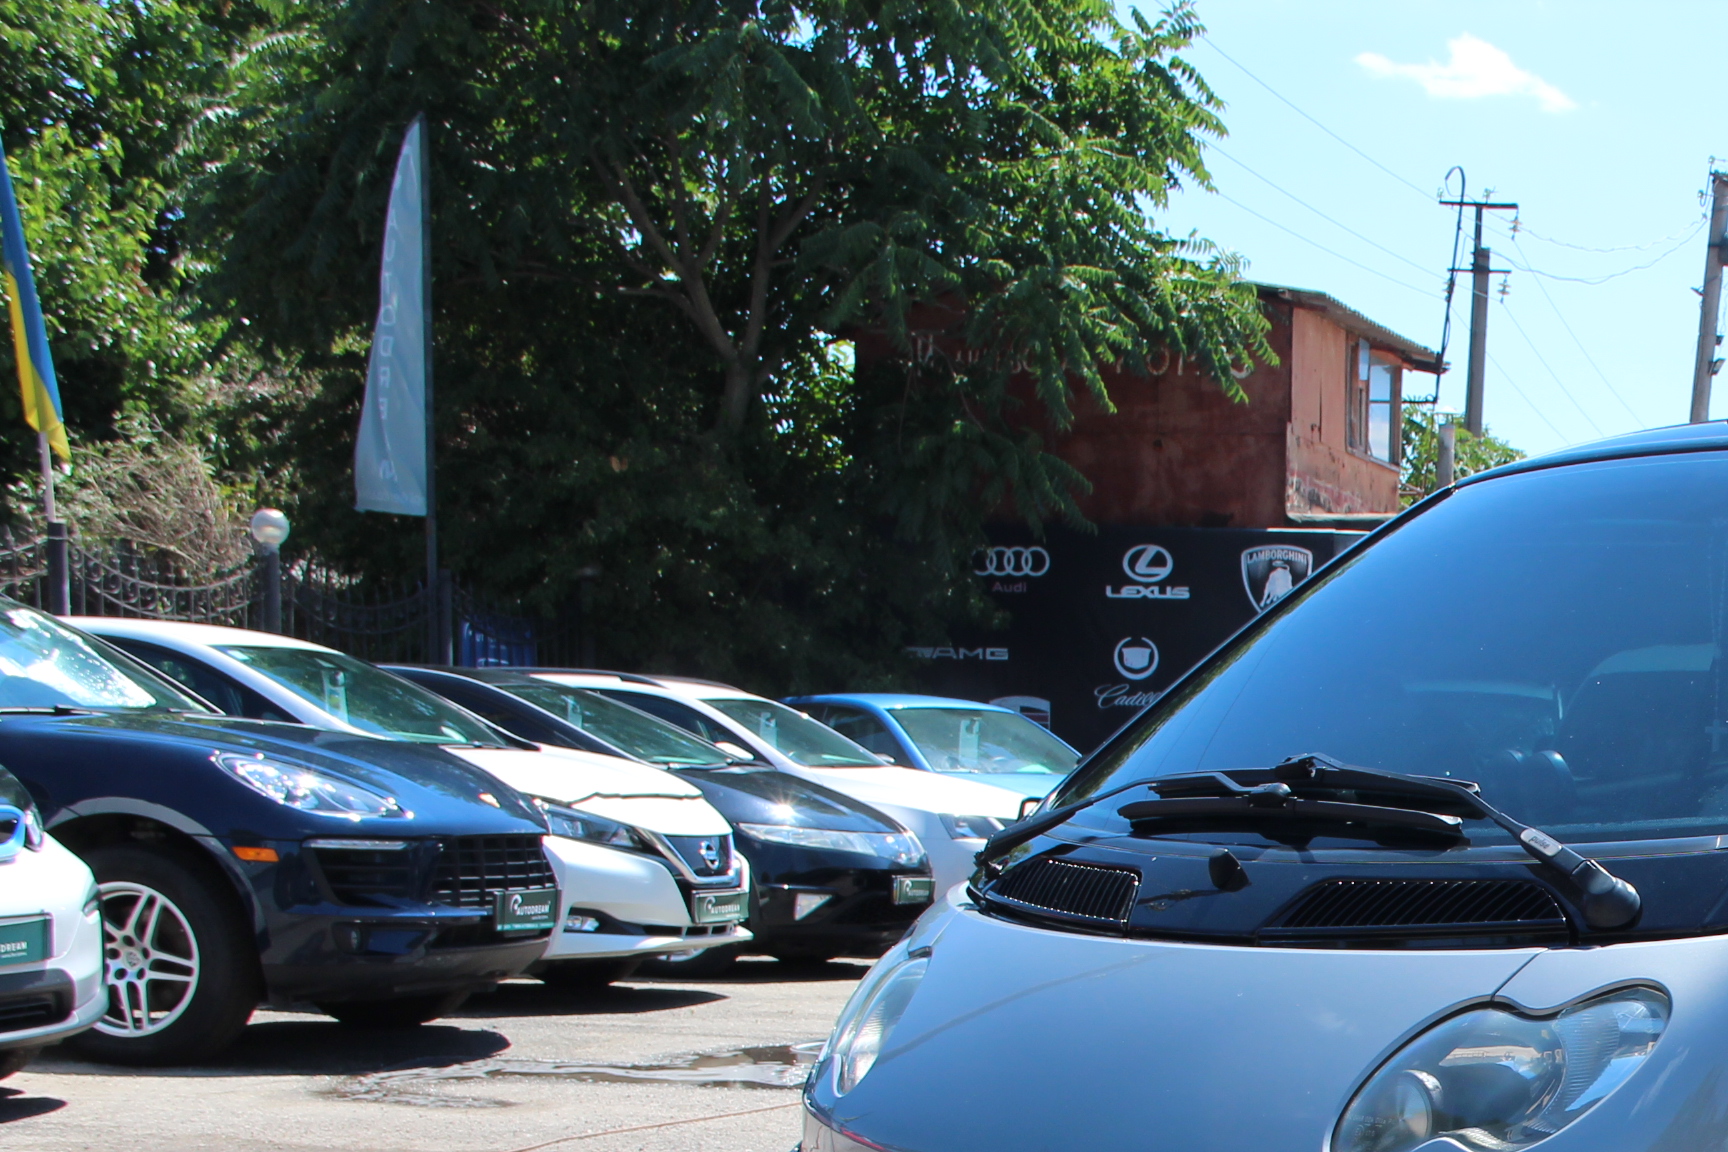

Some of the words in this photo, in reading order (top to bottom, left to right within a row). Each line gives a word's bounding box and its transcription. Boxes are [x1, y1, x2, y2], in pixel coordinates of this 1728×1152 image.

[1247, 549, 1307, 565] LAMBORGHINI
[992, 581, 1027, 593] Audi
[1105, 585, 1191, 599] LEXUS
[931, 646, 1009, 660] AMG
